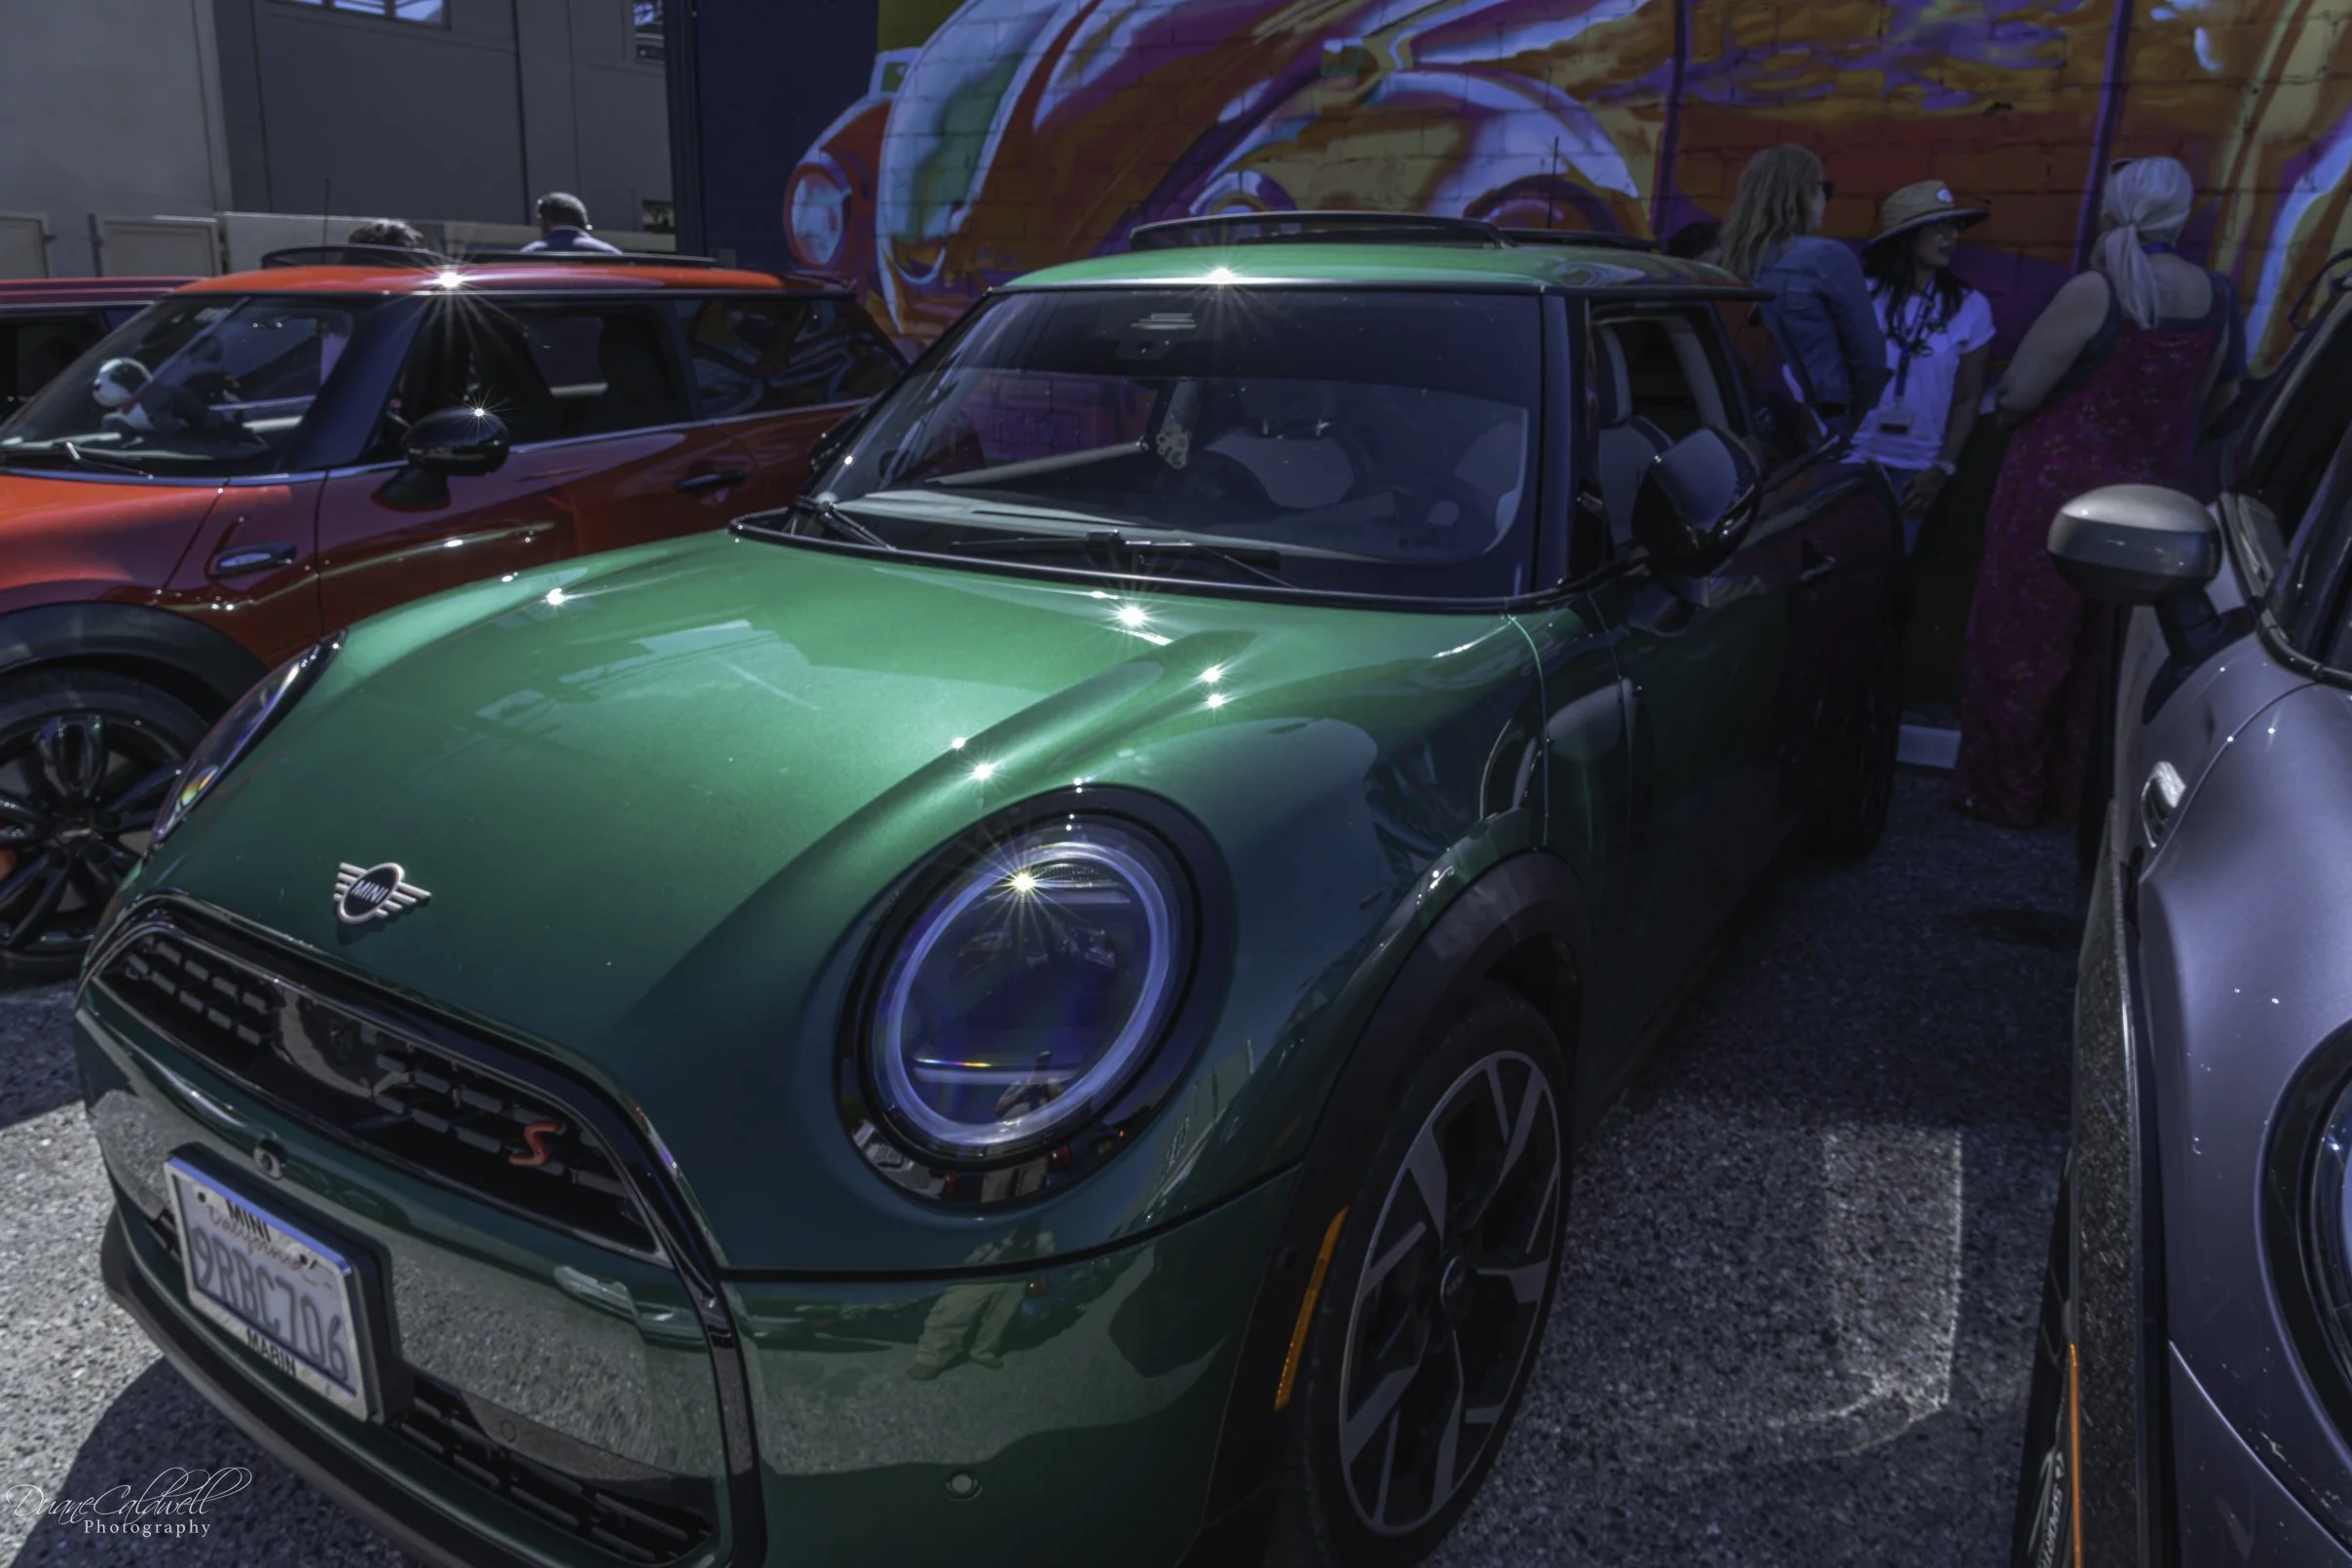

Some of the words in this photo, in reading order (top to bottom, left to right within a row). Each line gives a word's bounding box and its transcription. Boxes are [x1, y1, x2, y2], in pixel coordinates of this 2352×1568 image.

[351, 879, 390, 904] MINI
[509, 1122, 560, 1166] S
[225, 1199, 272, 1243] MINI
[190, 1225, 349, 1383] 9RBC706
[245, 1326, 297, 1379] MARIN
